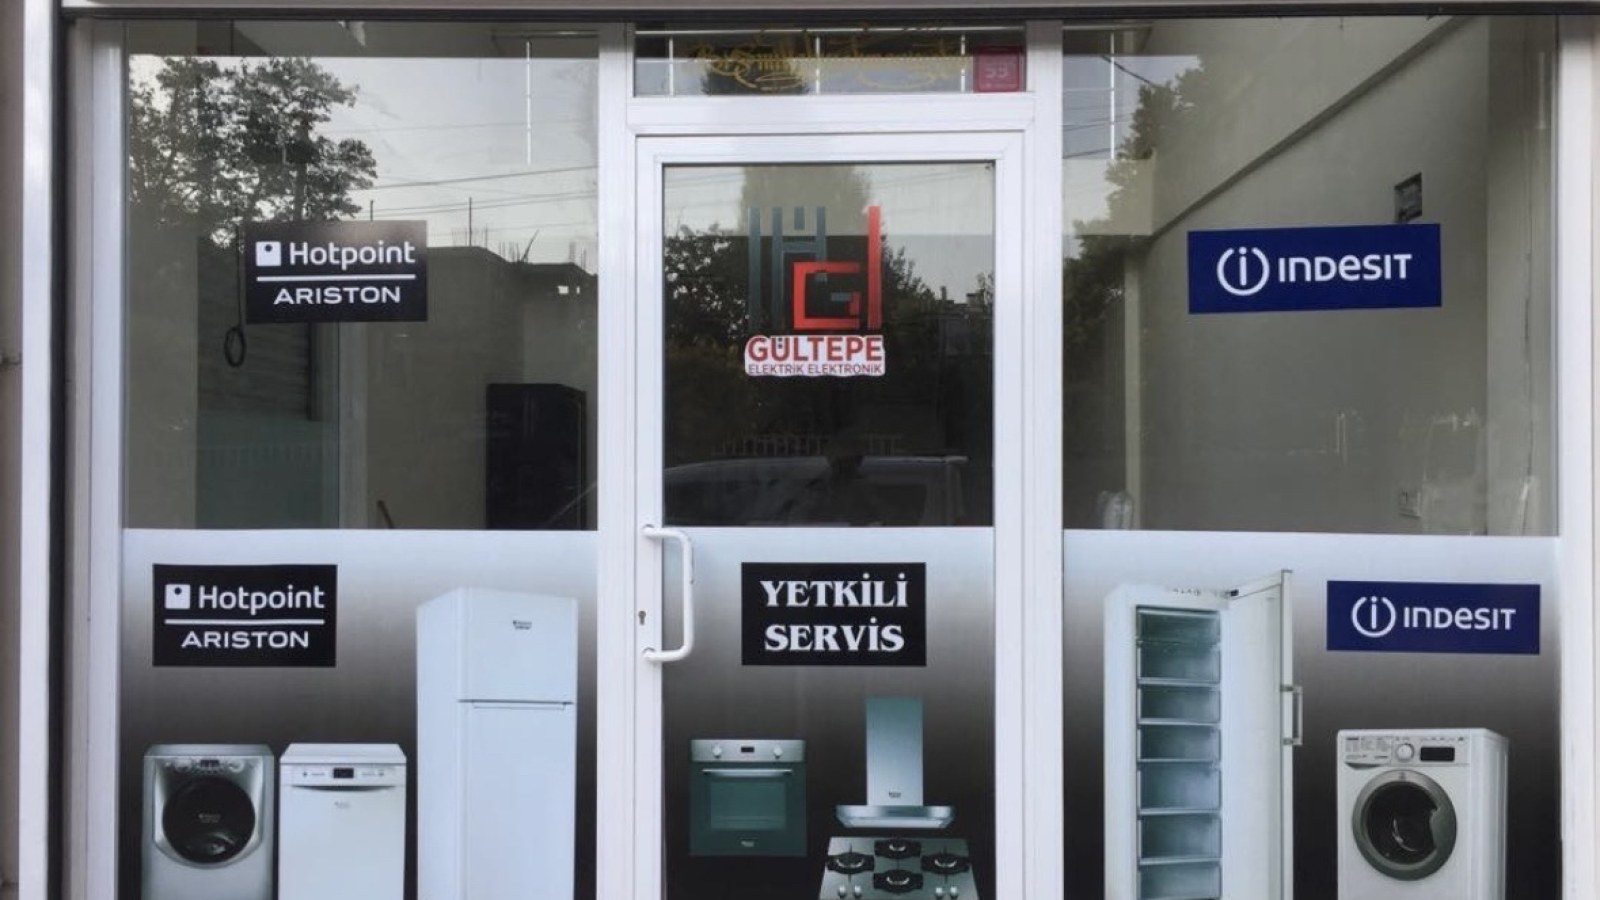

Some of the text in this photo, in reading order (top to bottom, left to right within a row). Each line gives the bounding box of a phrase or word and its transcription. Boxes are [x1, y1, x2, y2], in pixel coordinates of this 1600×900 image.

[289, 239, 416, 271] Hotpoint
[273, 286, 401, 305] ARISTON
[747, 335, 883, 362] GÜLTEPE
[199, 584, 325, 616] Hotpoint
[759, 572, 909, 607] YETKİLİ
[181, 630, 309, 649] ARISTON
[764, 616, 905, 652] SERVİS
